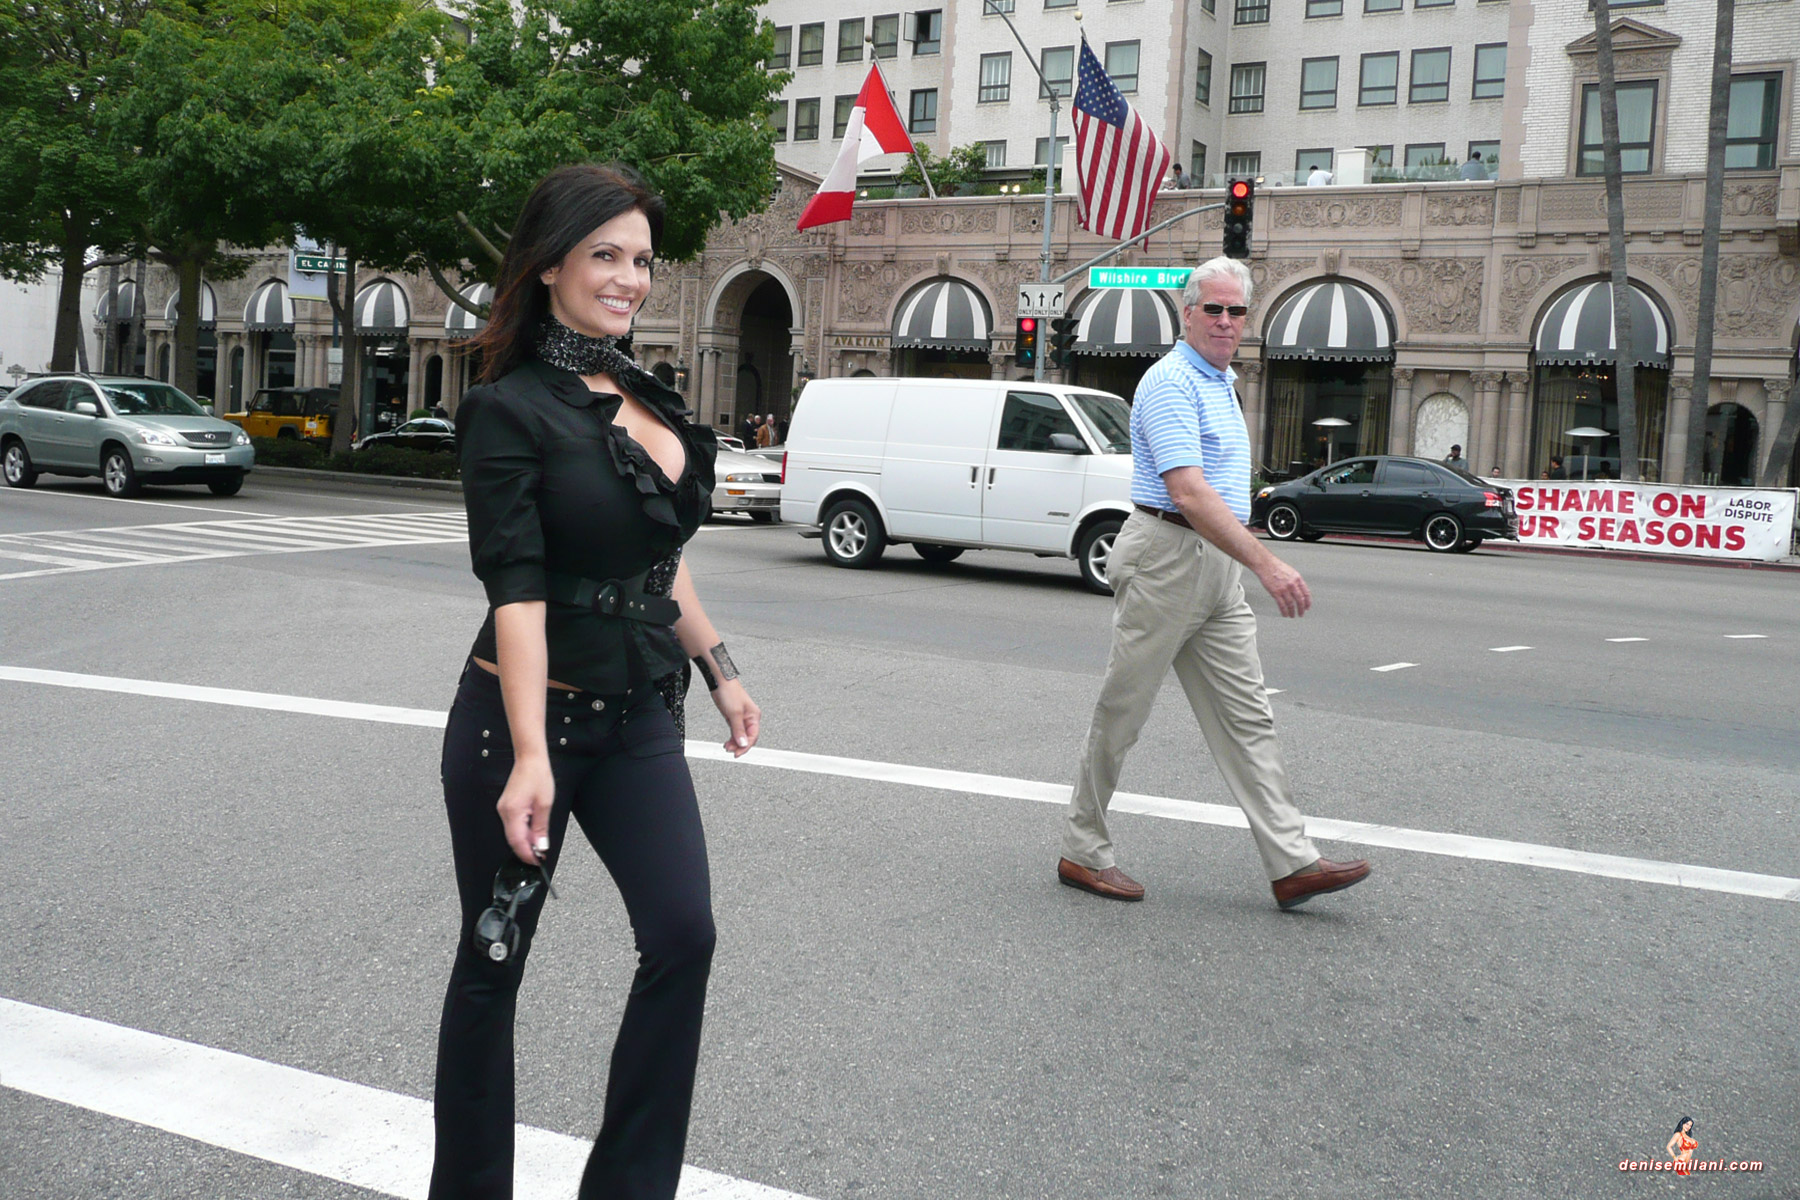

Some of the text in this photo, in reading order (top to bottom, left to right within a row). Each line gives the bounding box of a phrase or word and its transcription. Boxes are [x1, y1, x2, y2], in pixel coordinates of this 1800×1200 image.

[301, 259, 346, 269] EL CAIN
[1099, 272, 1185, 284] Wilshire Blvd
[1516, 487, 1706, 519] SHAME ON
[1729, 497, 1772, 511] LABOR
[1724, 508, 1774, 523] DISPUTE
[1518, 515, 1746, 551] UR SEASONS
